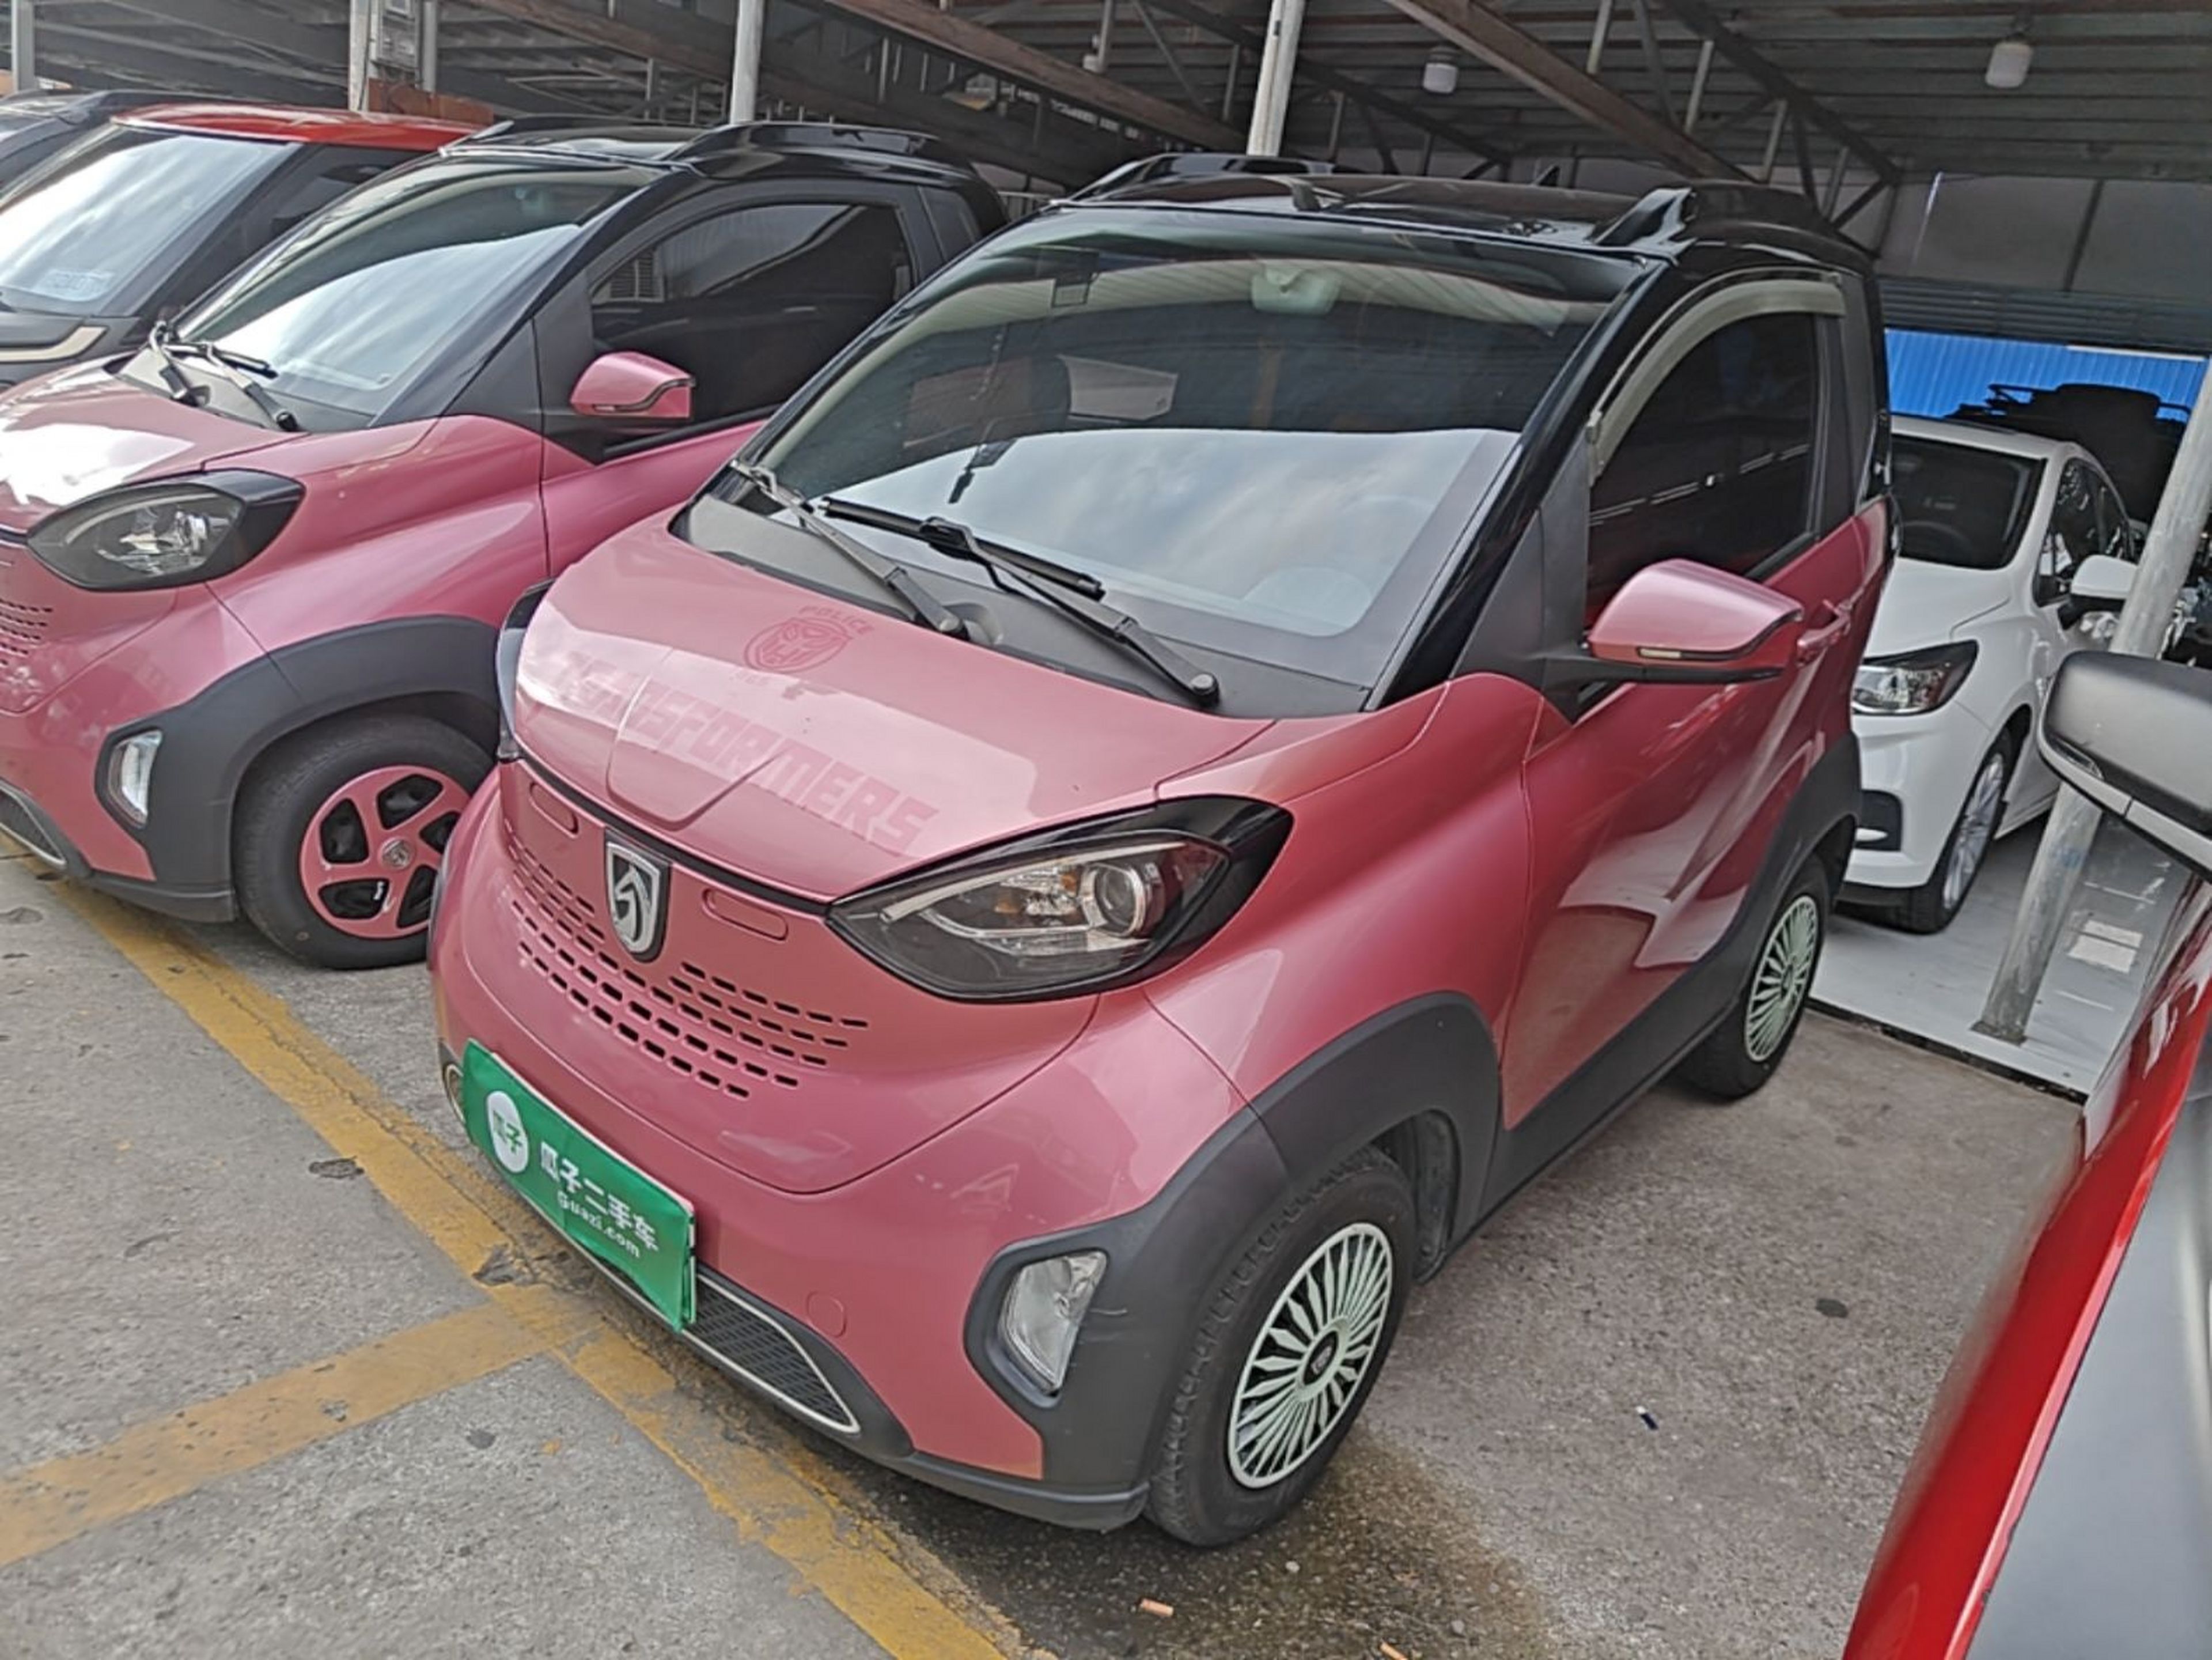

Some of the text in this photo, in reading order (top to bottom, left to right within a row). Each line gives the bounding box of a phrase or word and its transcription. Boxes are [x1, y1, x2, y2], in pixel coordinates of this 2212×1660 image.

[540, 1140, 659, 1252] 瓜子二手车
